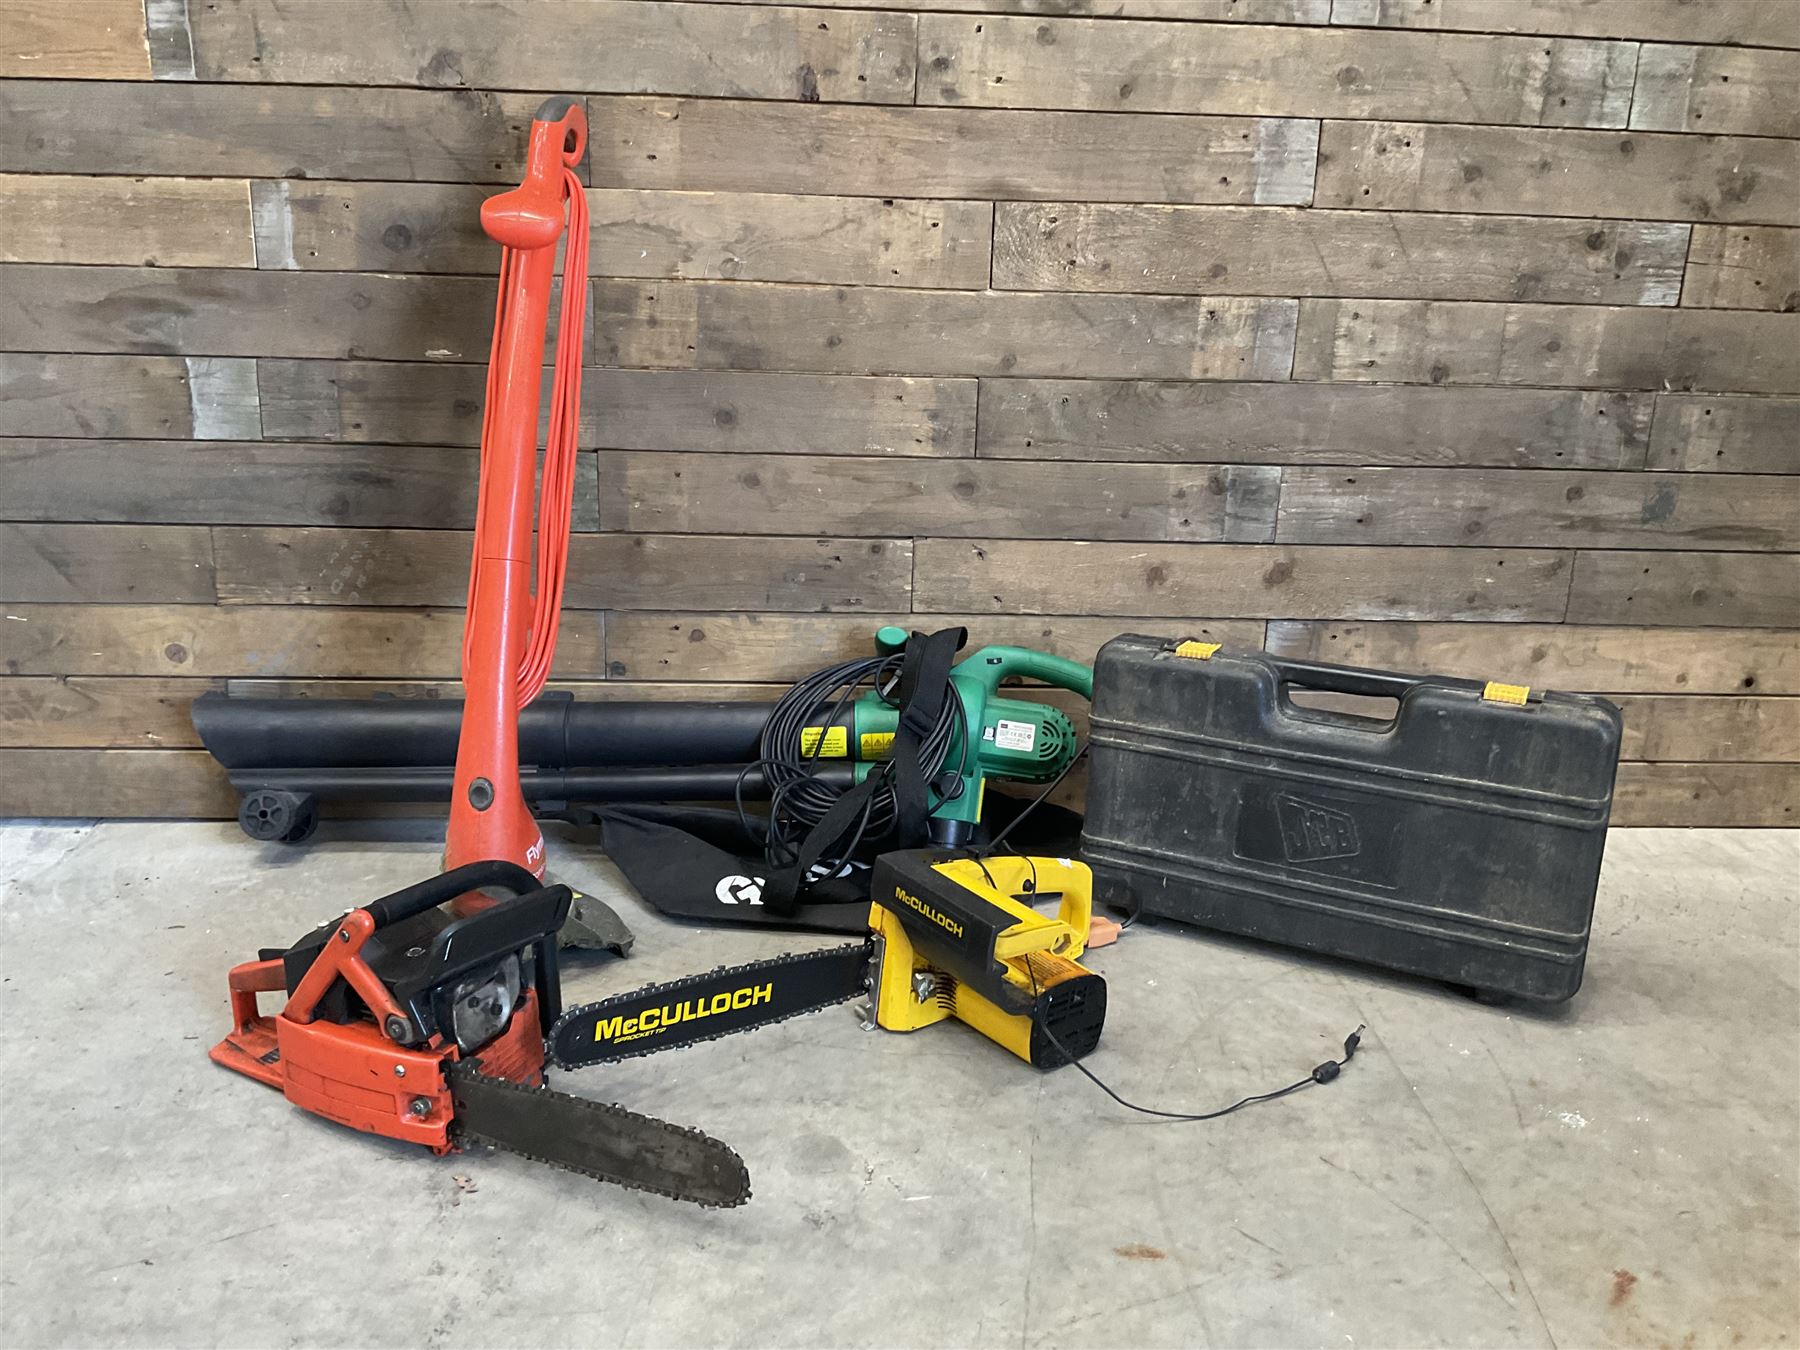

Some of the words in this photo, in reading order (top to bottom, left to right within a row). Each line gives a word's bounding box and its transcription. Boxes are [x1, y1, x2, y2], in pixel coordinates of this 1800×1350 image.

[895, 886, 963, 938] McCULLOCH
[594, 982, 773, 1042] McCULLOCH
[613, 1029, 655, 1044] SPROCKET
